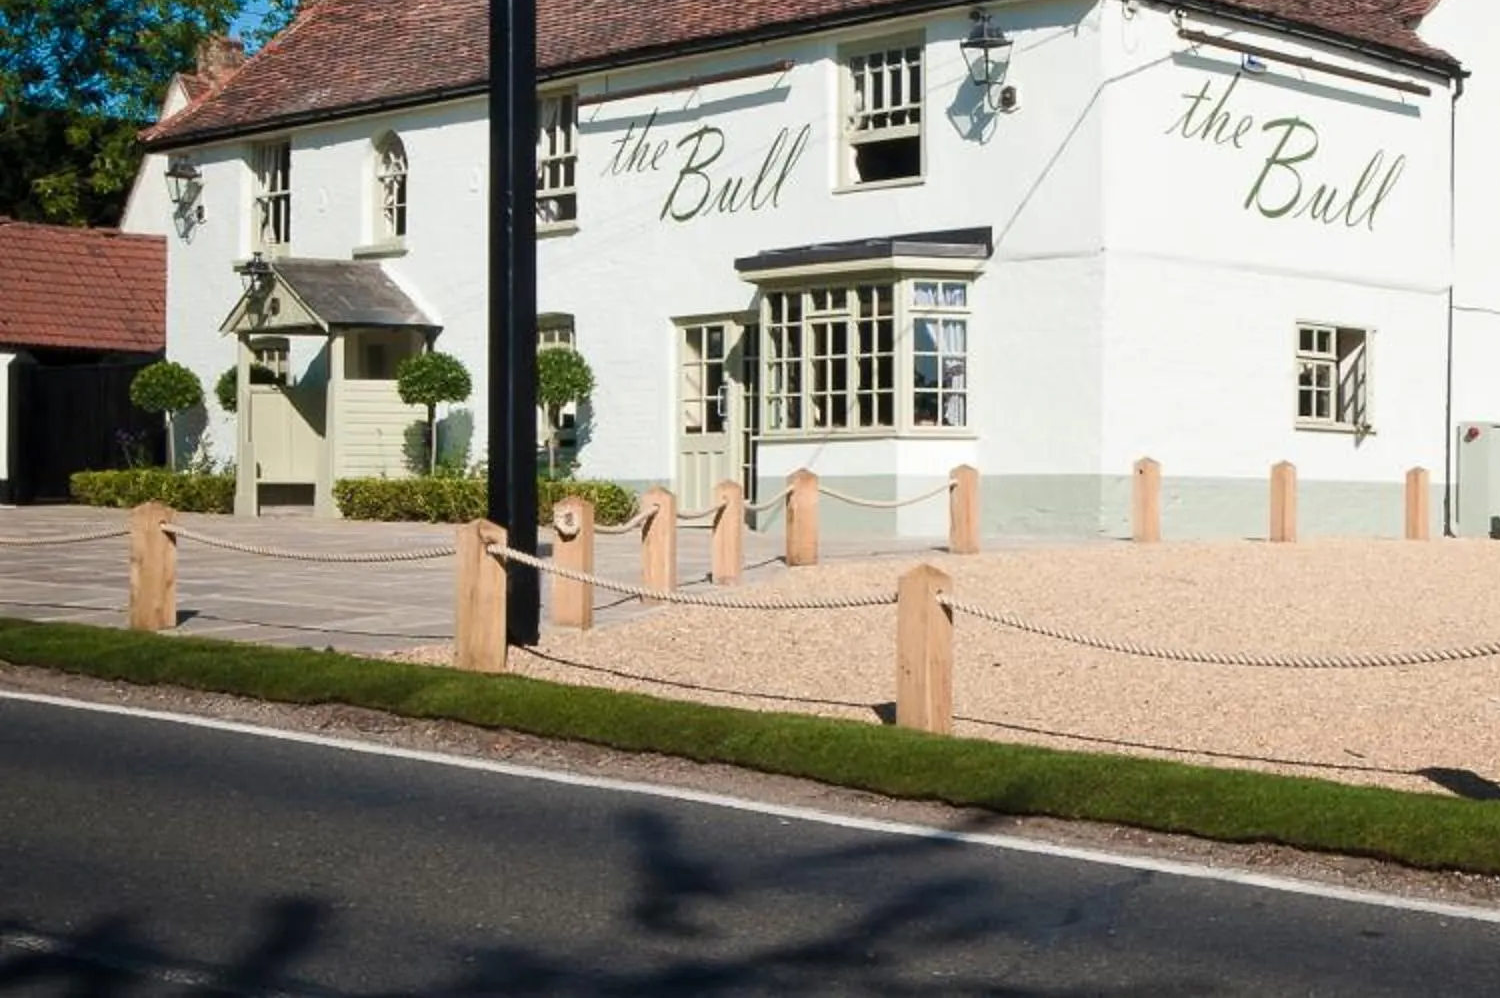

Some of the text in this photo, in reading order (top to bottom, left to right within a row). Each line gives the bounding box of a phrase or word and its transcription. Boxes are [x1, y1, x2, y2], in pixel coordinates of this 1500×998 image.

[600, 106, 812, 222] the Bull
[1164, 70, 1406, 232] the Bull
